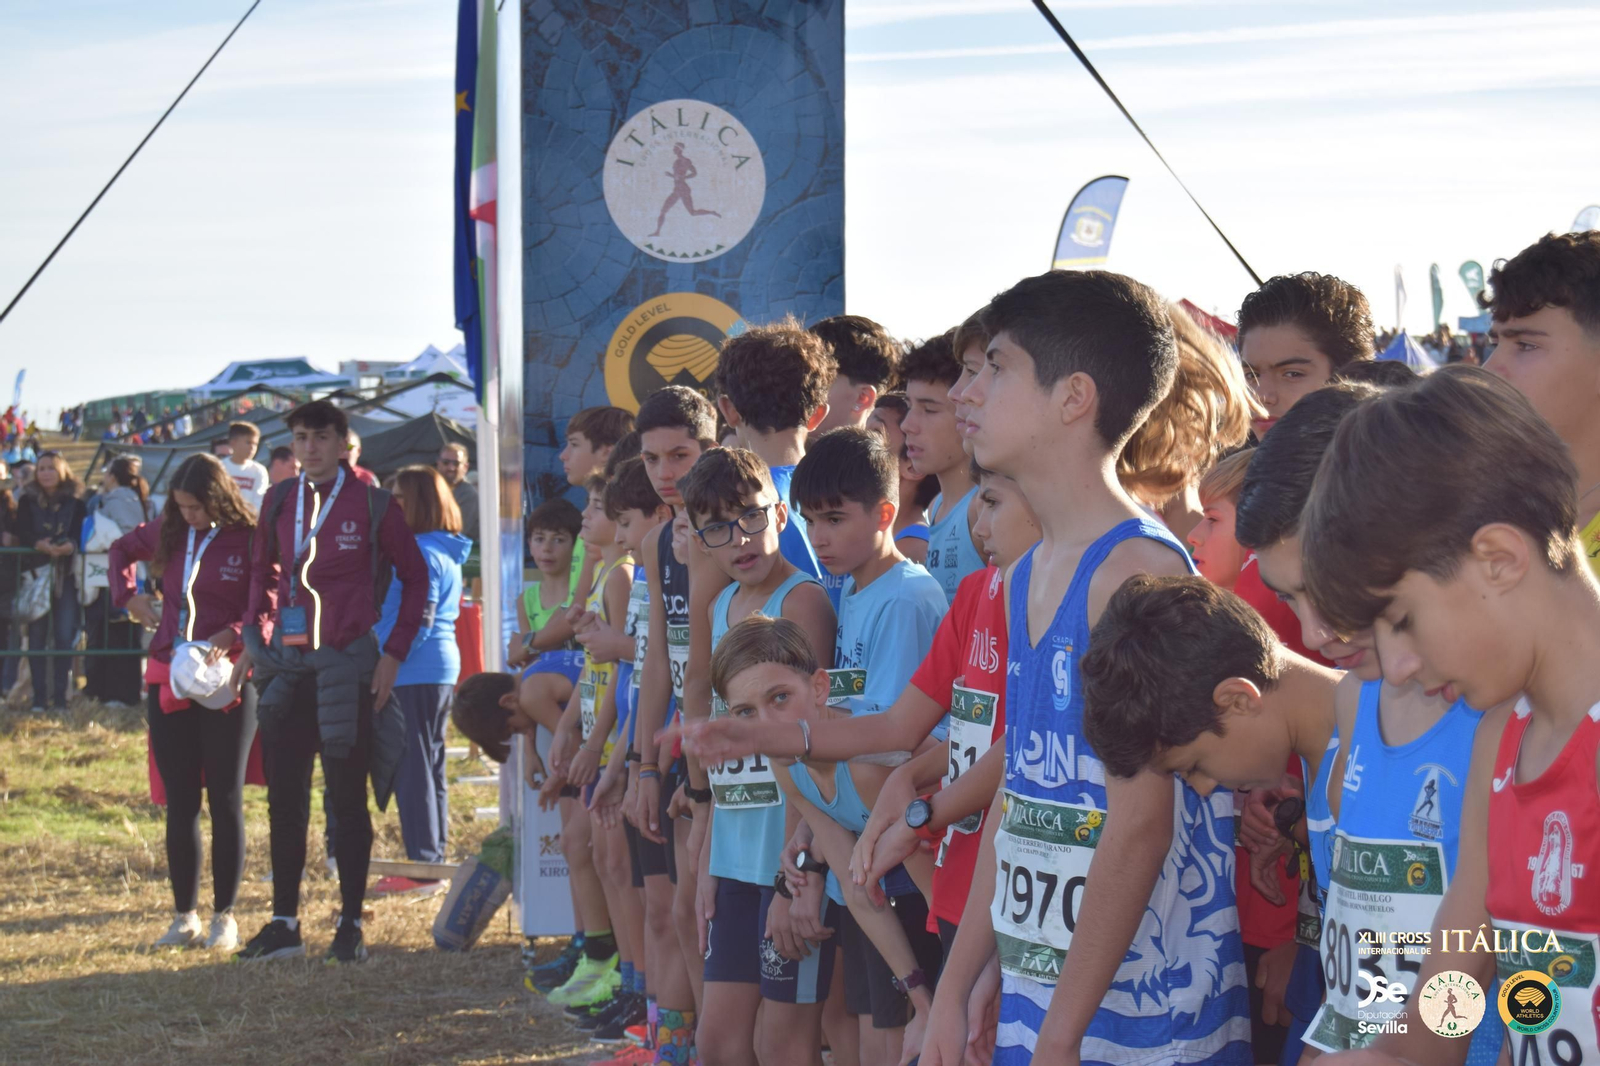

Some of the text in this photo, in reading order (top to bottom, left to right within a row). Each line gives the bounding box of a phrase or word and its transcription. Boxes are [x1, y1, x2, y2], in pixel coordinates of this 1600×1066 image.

[616, 107, 751, 170] ITÁLICA
[615, 303, 672, 358] GOLD LEVEL
[1527, 856, 1584, 878] 19 67
[1001, 859, 1087, 934] 7970
[1357, 891, 1392, 903] HIDALGO
[1535, 899, 1567, 916] HUELVA
